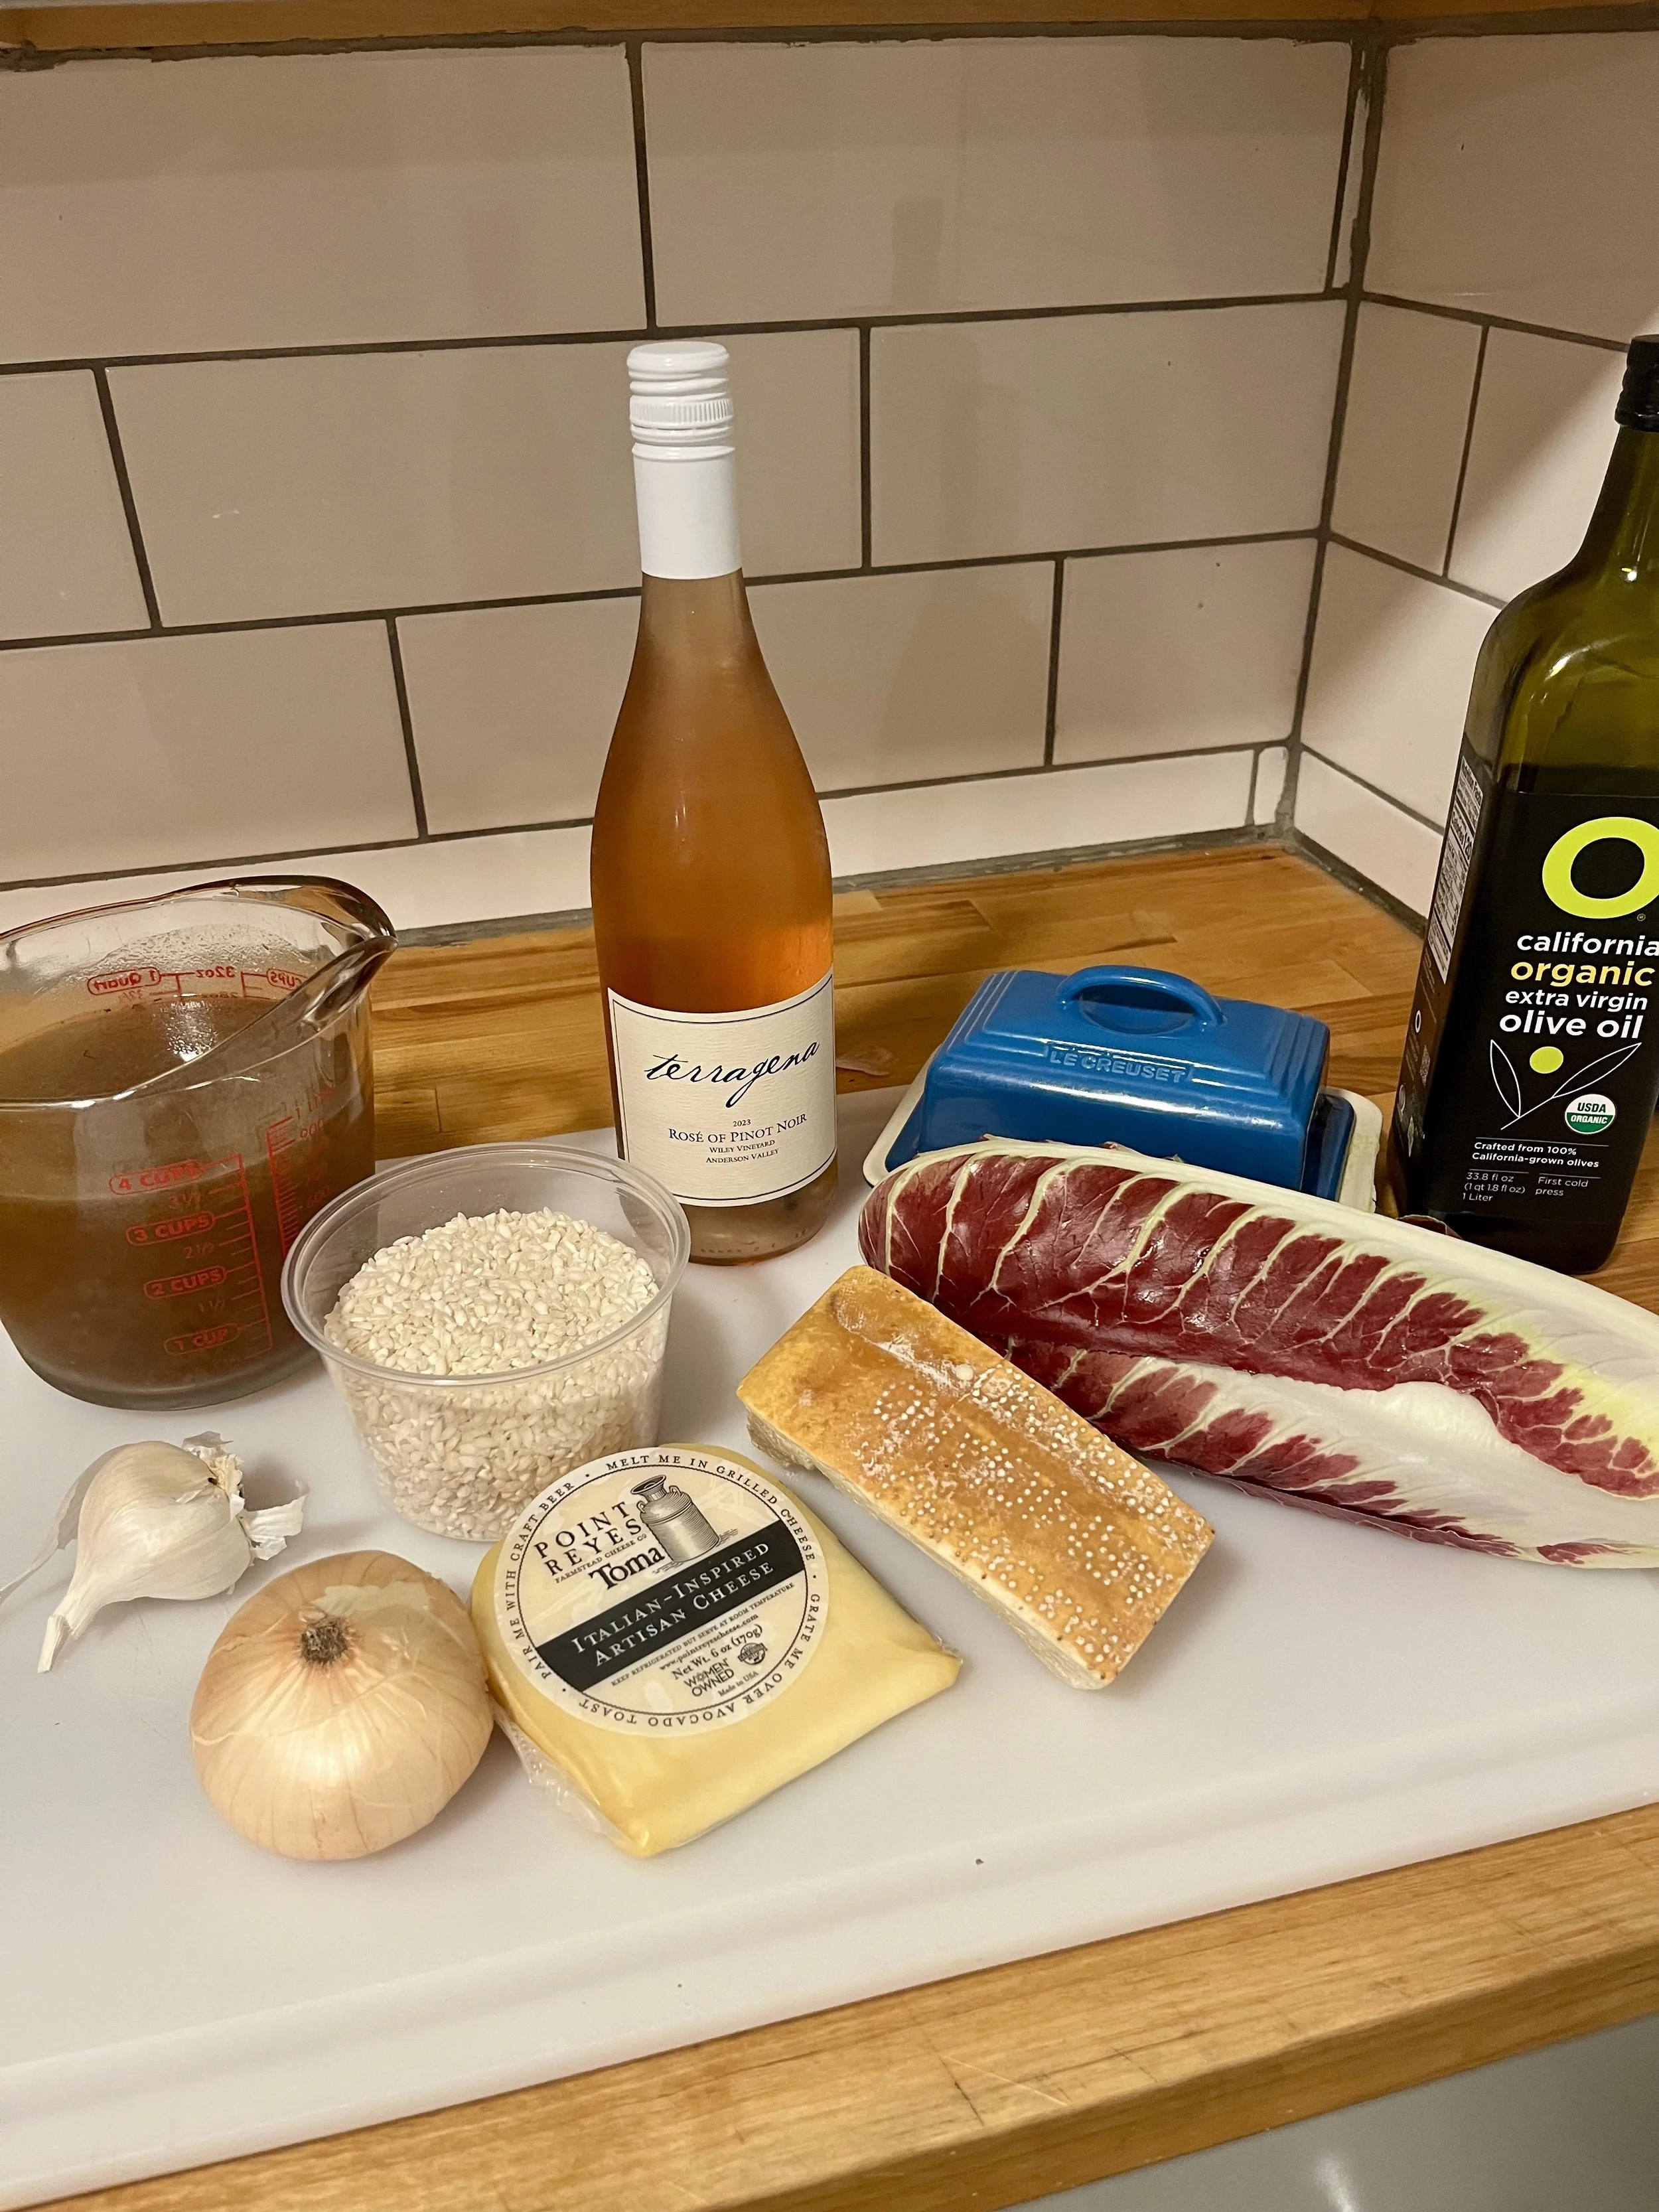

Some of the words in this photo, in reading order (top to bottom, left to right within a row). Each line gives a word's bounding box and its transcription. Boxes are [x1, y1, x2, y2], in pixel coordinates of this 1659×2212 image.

[1517, 932, 1659, 956] california
[1511, 961, 1655, 987] organic
[1505, 990, 1568, 1007] extra
[1576, 991, 1648, 1012] virgin
[1499, 1010, 1586, 1035] olive
[1597, 1015, 1644, 1039] oil
[644, 1042, 820, 1108] terragena
[1049, 1051, 1078, 1066] LE
[1082, 1057, 1186, 1082] CREUSET
[1571, 1114, 1608, 1124] ORGANIC
[1577, 1102, 1606, 1113] USDA
[668, 1128, 703, 1143] ROSÉ
[707, 1134, 725, 1143] OF
[731, 1126, 773, 1142] PINOT
[776, 1114, 807, 1134] NOIR
[733, 1119, 751, 1128] 2023
[737, 1140, 775, 1151] VINEYARD
[751, 1148, 779, 1159] VALLEY
[1474, 1142, 1515, 1151] Crafted
[1518, 1144, 1544, 1153] from
[1548, 1146, 1577, 1155] 100%
[1472, 1152, 1564, 1165] California-grown
[1567, 1159, 1599, 1168] olives
[1466, 1172, 1488, 1181] 33.8
[1475, 1183, 1484, 1193] qt
[1501, 1184, 1507, 1193] fl
[1509, 1185, 1526, 1194] oz)
[1538, 1177, 1561, 1186] First
[1565, 1179, 1589, 1187] cold
[1469, 1193, 1493, 1202] Liter
[134, 1228, 148, 1241] 3
[155, 1217, 210, 1238] CUPS
[151, 1283, 164, 1296] 2
[170, 1269, 222, 1291] CUPS
[192, 1327, 228, 1347] CUP
[539, 1483, 575, 1511] BEER
[606, 1455, 649, 1470] MELT
[658, 1455, 680, 1463] ME
[690, 1458, 708, 1469] IN
[716, 1465, 777, 1505] GRILLED
[780, 1509, 815, 1560] CHEESE
[510, 1514, 539, 1561] CRAFT
[534, 1501, 630, 1558] POINT
[544, 1518, 641, 1576] REYES
[555, 1557, 603, 1584] FARMSTEAD
[605, 1540, 636, 1558] CHEESE
[588, 1547, 665, 1589] Toma
[506, 1570, 516, 1611] WITH
[596, 1608, 686, 1666] ARTISAN
[693, 1562, 774, 1610] CHEESE
[800, 1593, 820, 1642] GRATE
[510, 1618, 525, 1639] ME
[611, 1673, 630, 1686] KEEP
[632, 1645, 682, 1675] REFRIGERATED
[683, 1636, 696, 1647] BUT
[697, 1625, 719, 1639] SERVE
[719, 1619, 729, 1628] AT
[729, 1608, 749, 1621] ROOM
[749, 1582, 795, 1611] TEMPERATURE
[660, 1614, 758, 1670] www.pointreyescheese.com
[672, 1665, 693, 1680] Net
[690, 1655, 711, 1668] Wt.
[711, 1648, 719, 1658] 6
[721, 1644, 732, 1653] oz
[731, 1623, 762, 1646] (170g)
[523, 1646, 552, 1679] PAIR
[784, 1647, 803, 1669] ME
[691, 1668, 735, 1697] OWNED
[717, 1685, 736, 1696] Made
[743, 1670, 758, 1682] USA
[743, 1672, 782, 1704] OVER
[579, 1698, 637, 1724] TOAST
[648, 1703, 735, 1727] AVOCADO
